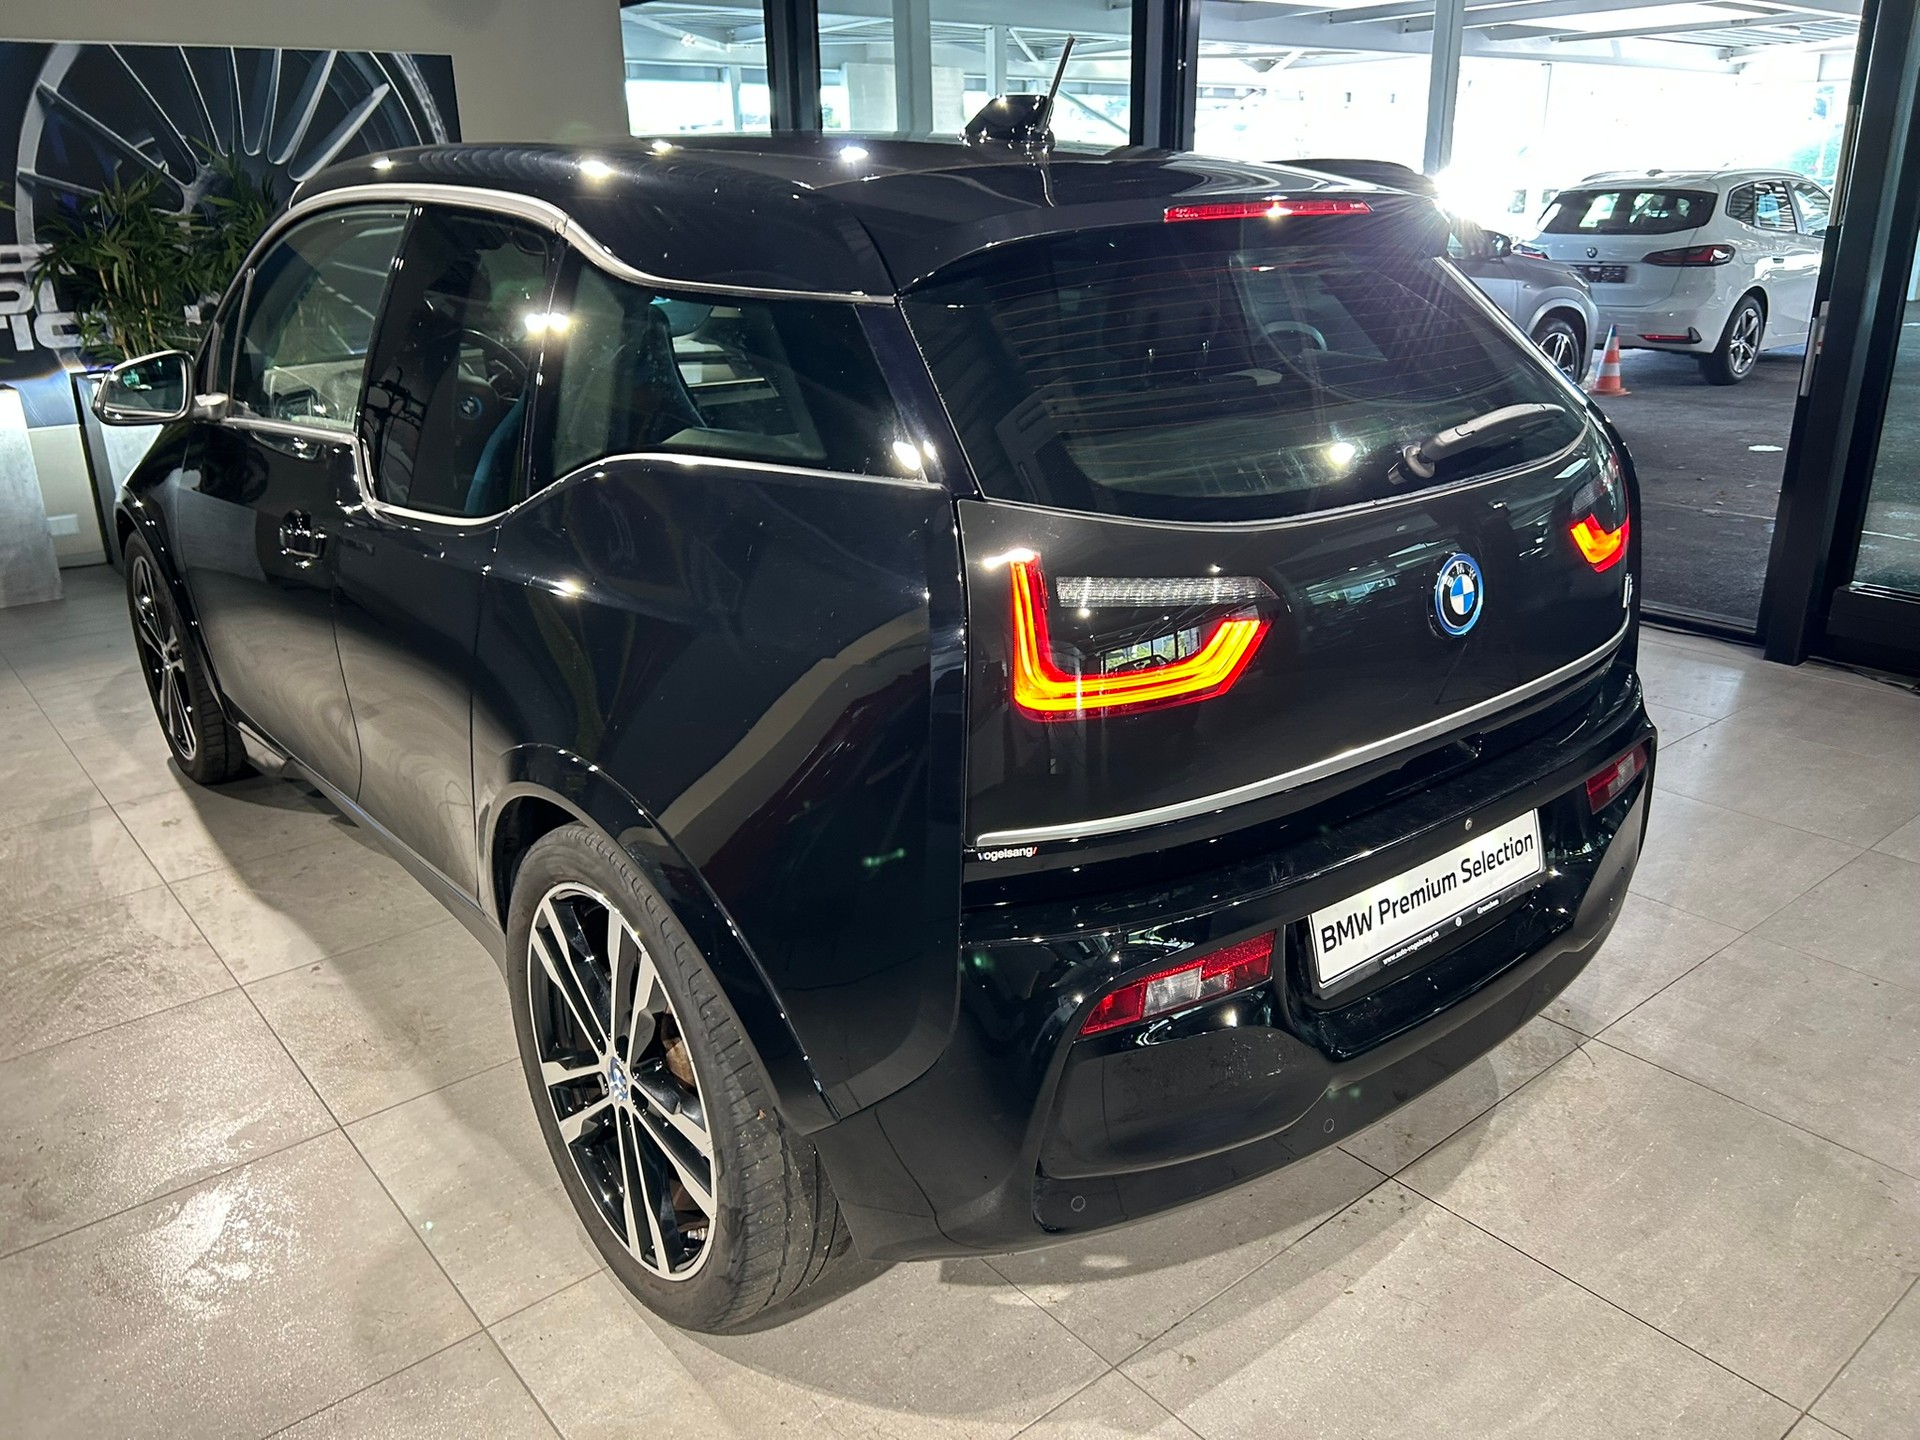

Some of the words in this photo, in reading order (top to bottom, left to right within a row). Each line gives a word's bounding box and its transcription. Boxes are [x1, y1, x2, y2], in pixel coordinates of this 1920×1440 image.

[1445, 563, 1477, 588] BMW
[1321, 905, 1373, 953] BMW
[1378, 869, 1458, 925] Premium
[1460, 833, 1535, 884] Selection
